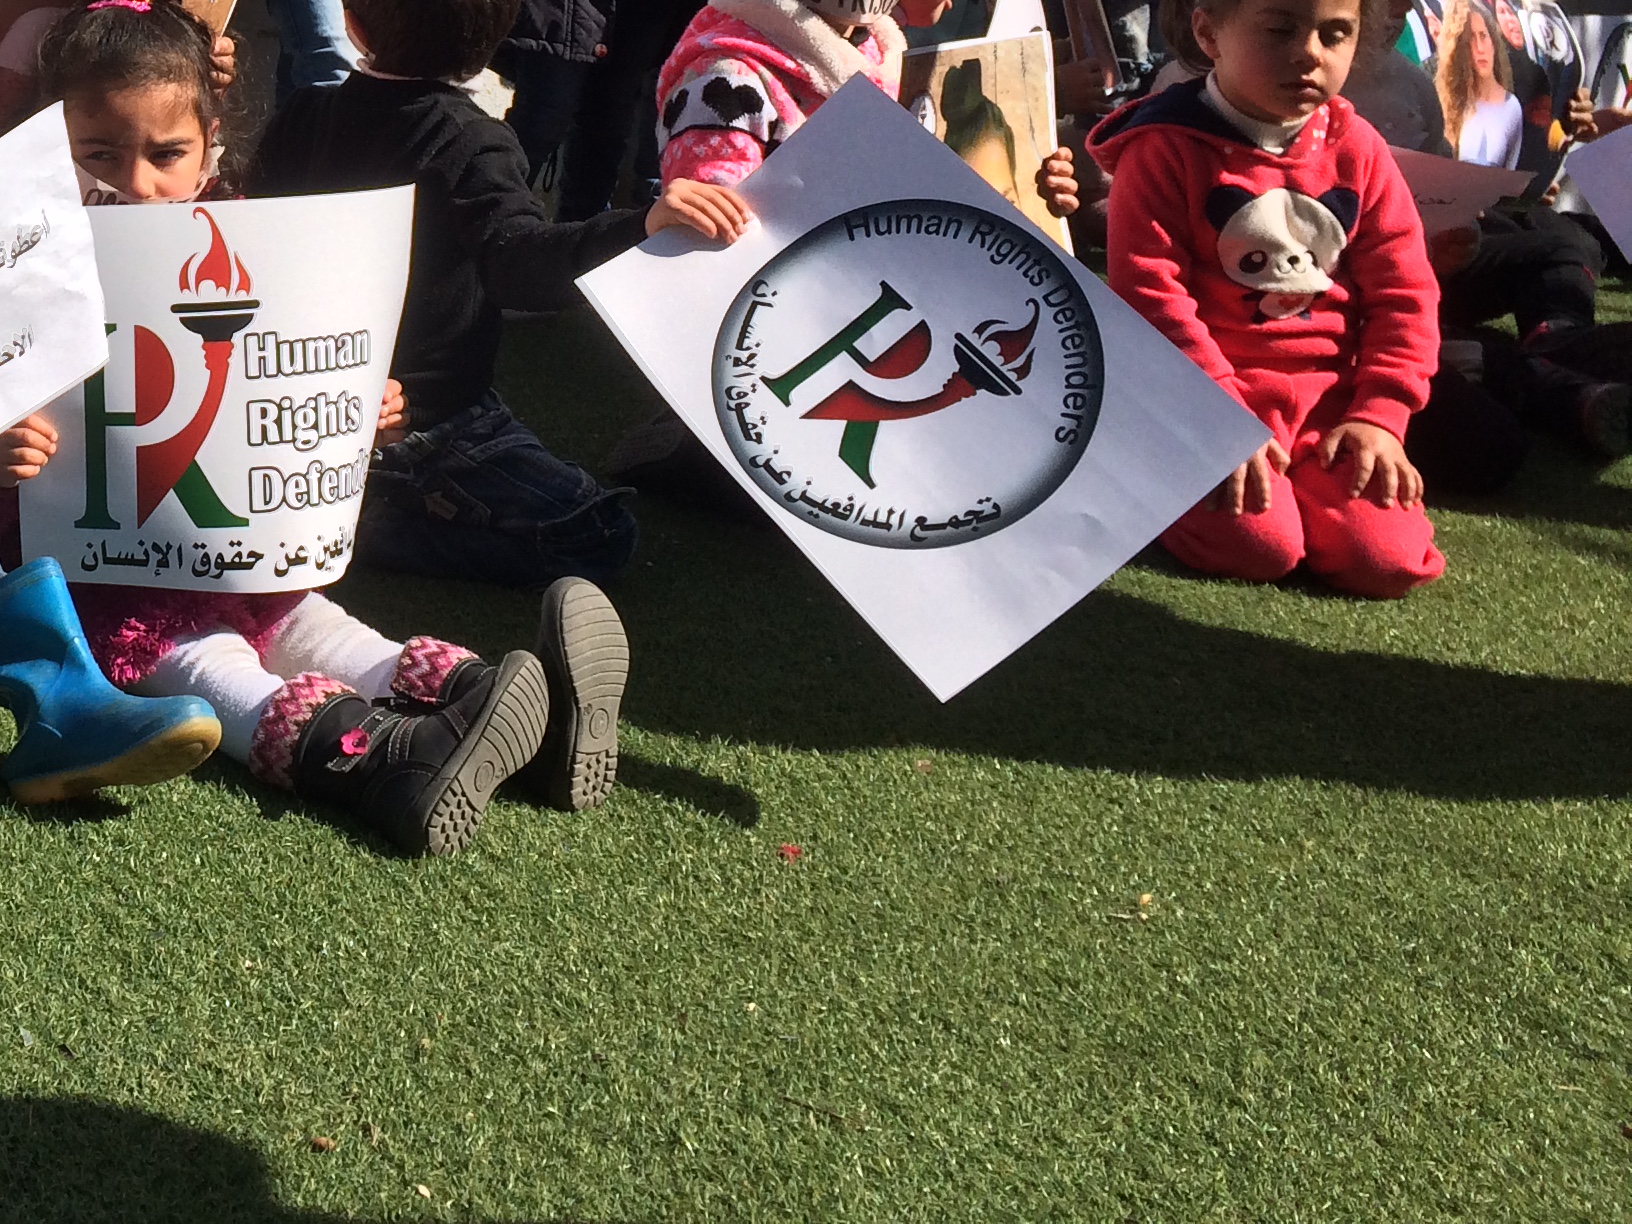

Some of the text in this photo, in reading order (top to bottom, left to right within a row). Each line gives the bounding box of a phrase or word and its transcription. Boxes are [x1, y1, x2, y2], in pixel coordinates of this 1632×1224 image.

[844, 213, 1097, 446] Human Rights Defenders
[244, 329, 371, 380] Human
[246, 390, 364, 452] Rights
[724, 378, 768, 445] حقوق
[749, 445, 793, 486] عن
[784, 476, 908, 533] المدافعين
[909, 496, 1001, 543] تجمع
[80, 539, 183, 577] الإنسان
[191, 539, 265, 580] حقوق
[273, 540, 310, 577] عن
